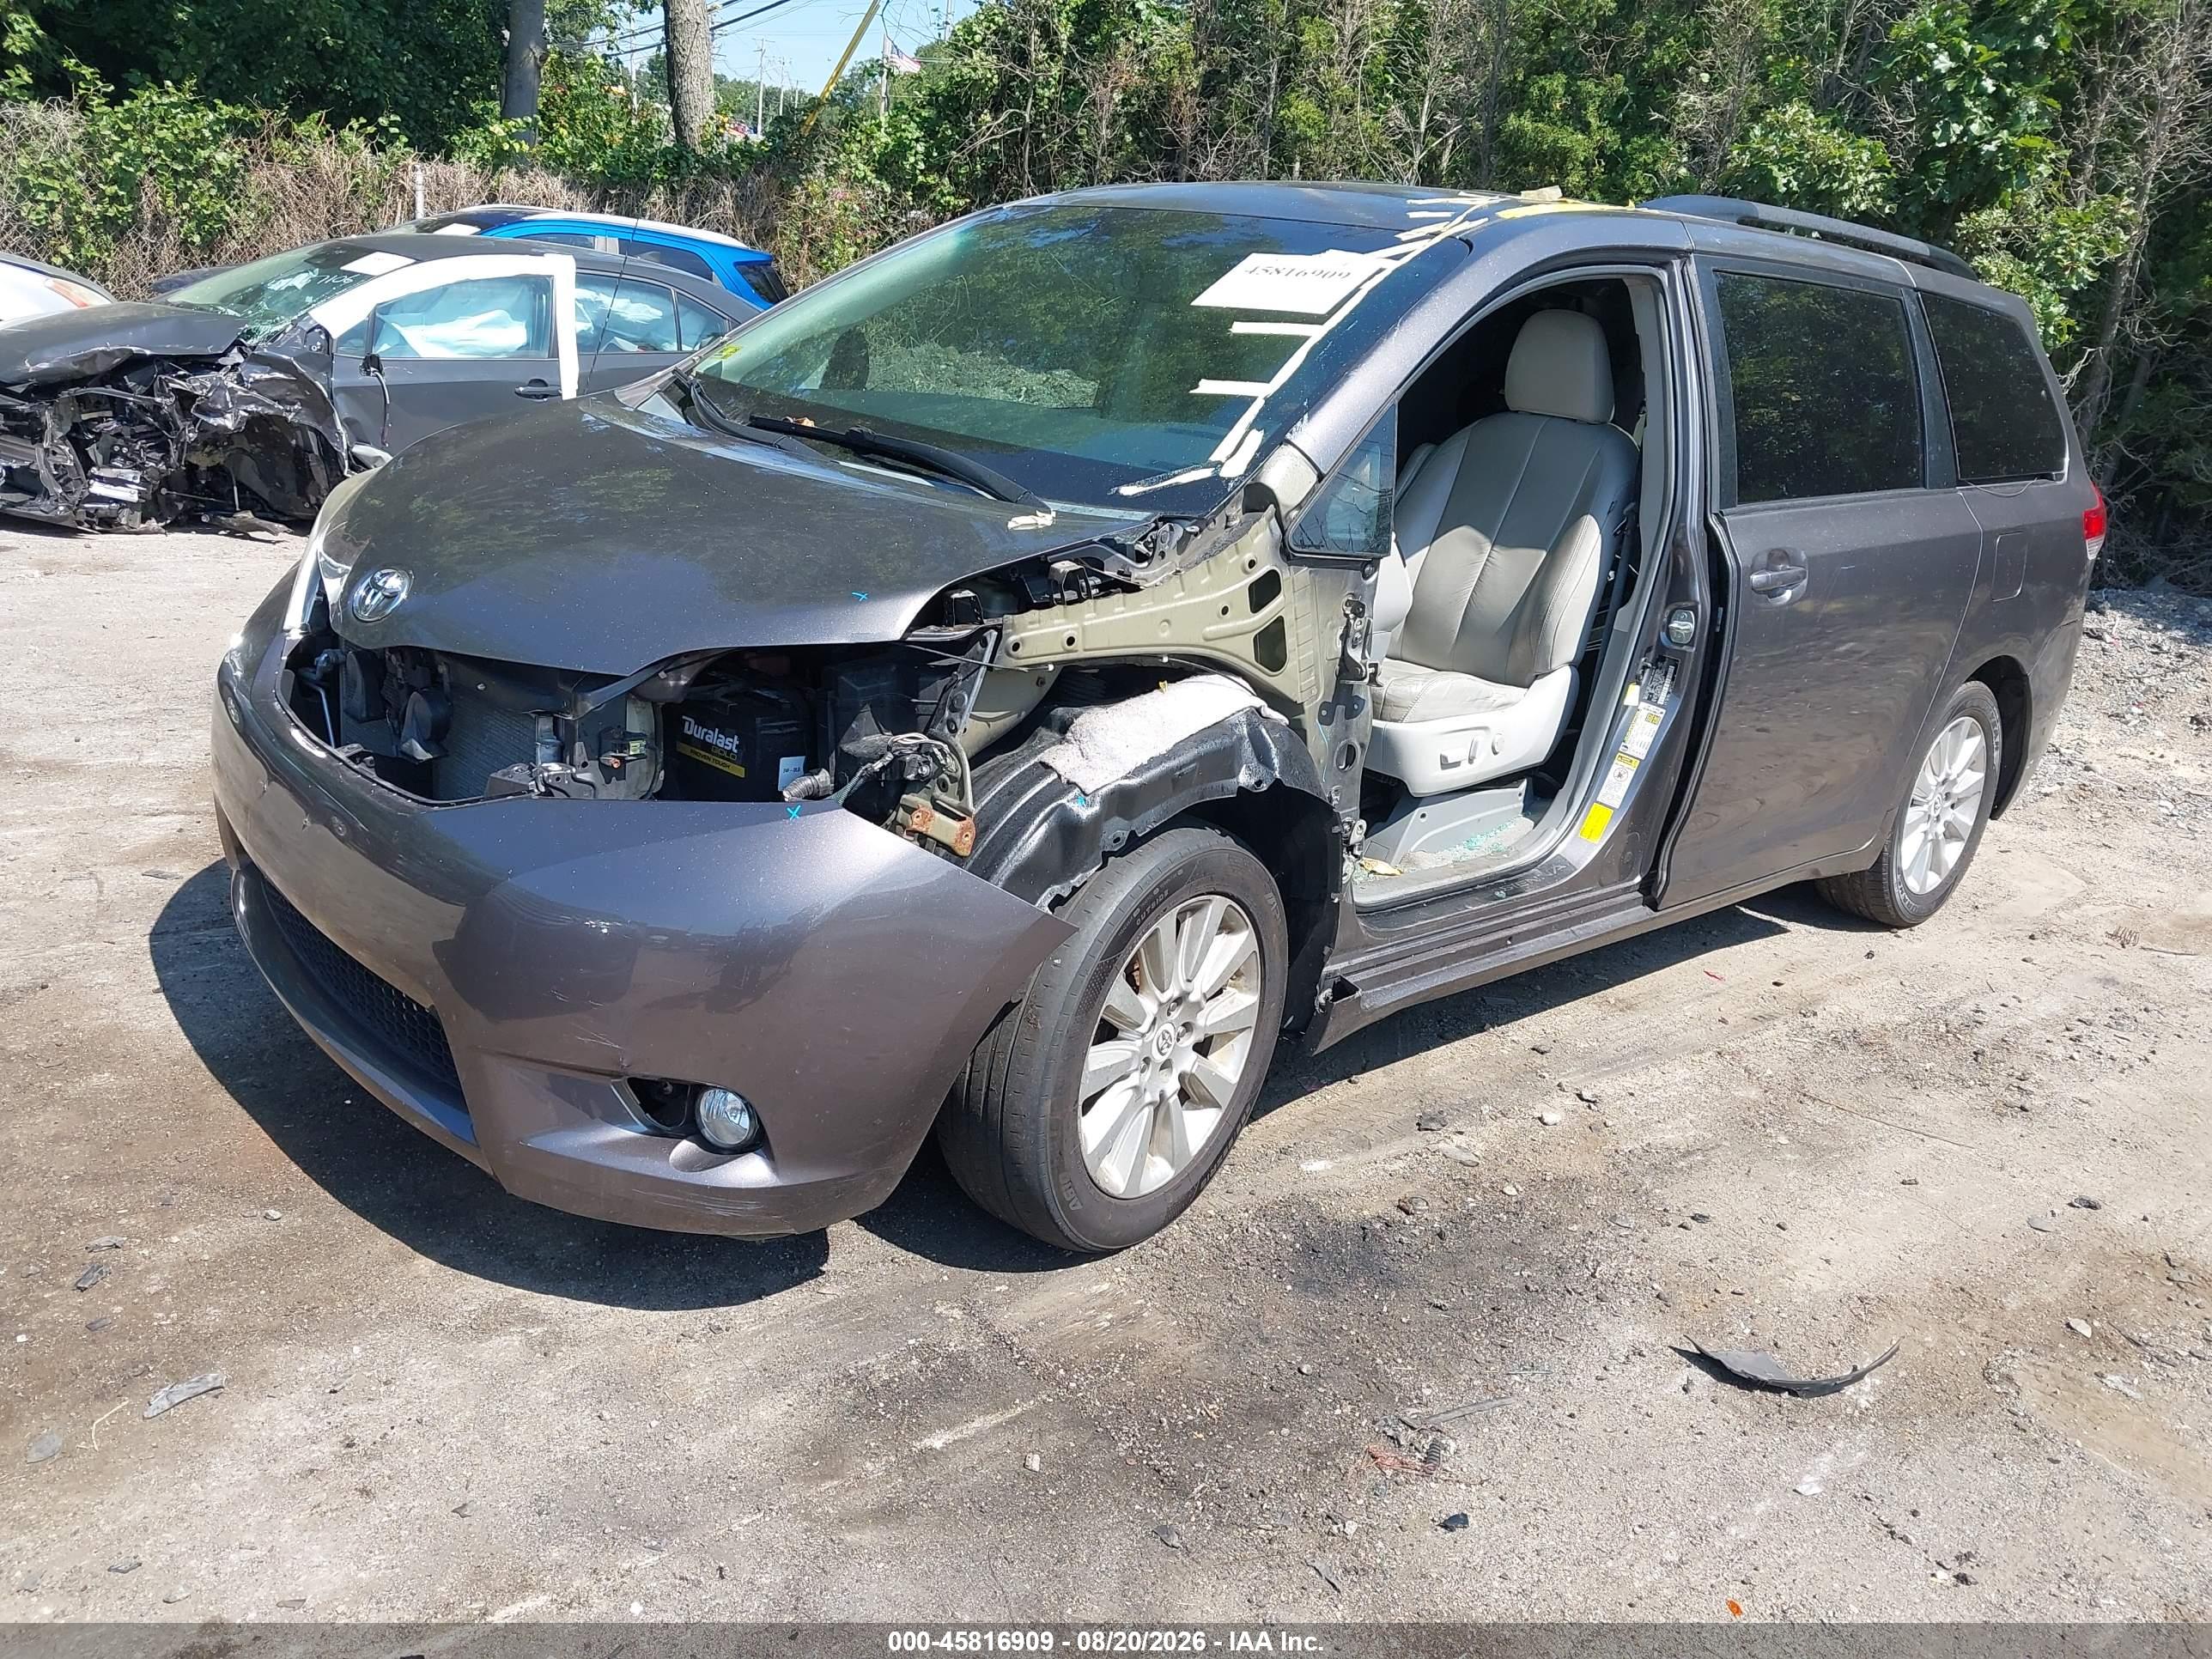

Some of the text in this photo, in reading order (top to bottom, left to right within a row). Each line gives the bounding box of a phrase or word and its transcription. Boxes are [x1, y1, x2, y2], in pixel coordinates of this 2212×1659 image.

[1244, 265, 1351, 279] 45816909
[682, 715, 740, 754] Duralast
[690, 749, 731, 769] PROVEN TOUGH
[711, 745, 738, 762] GOLD
[1136, 889, 1169, 926] OUTSIDE
